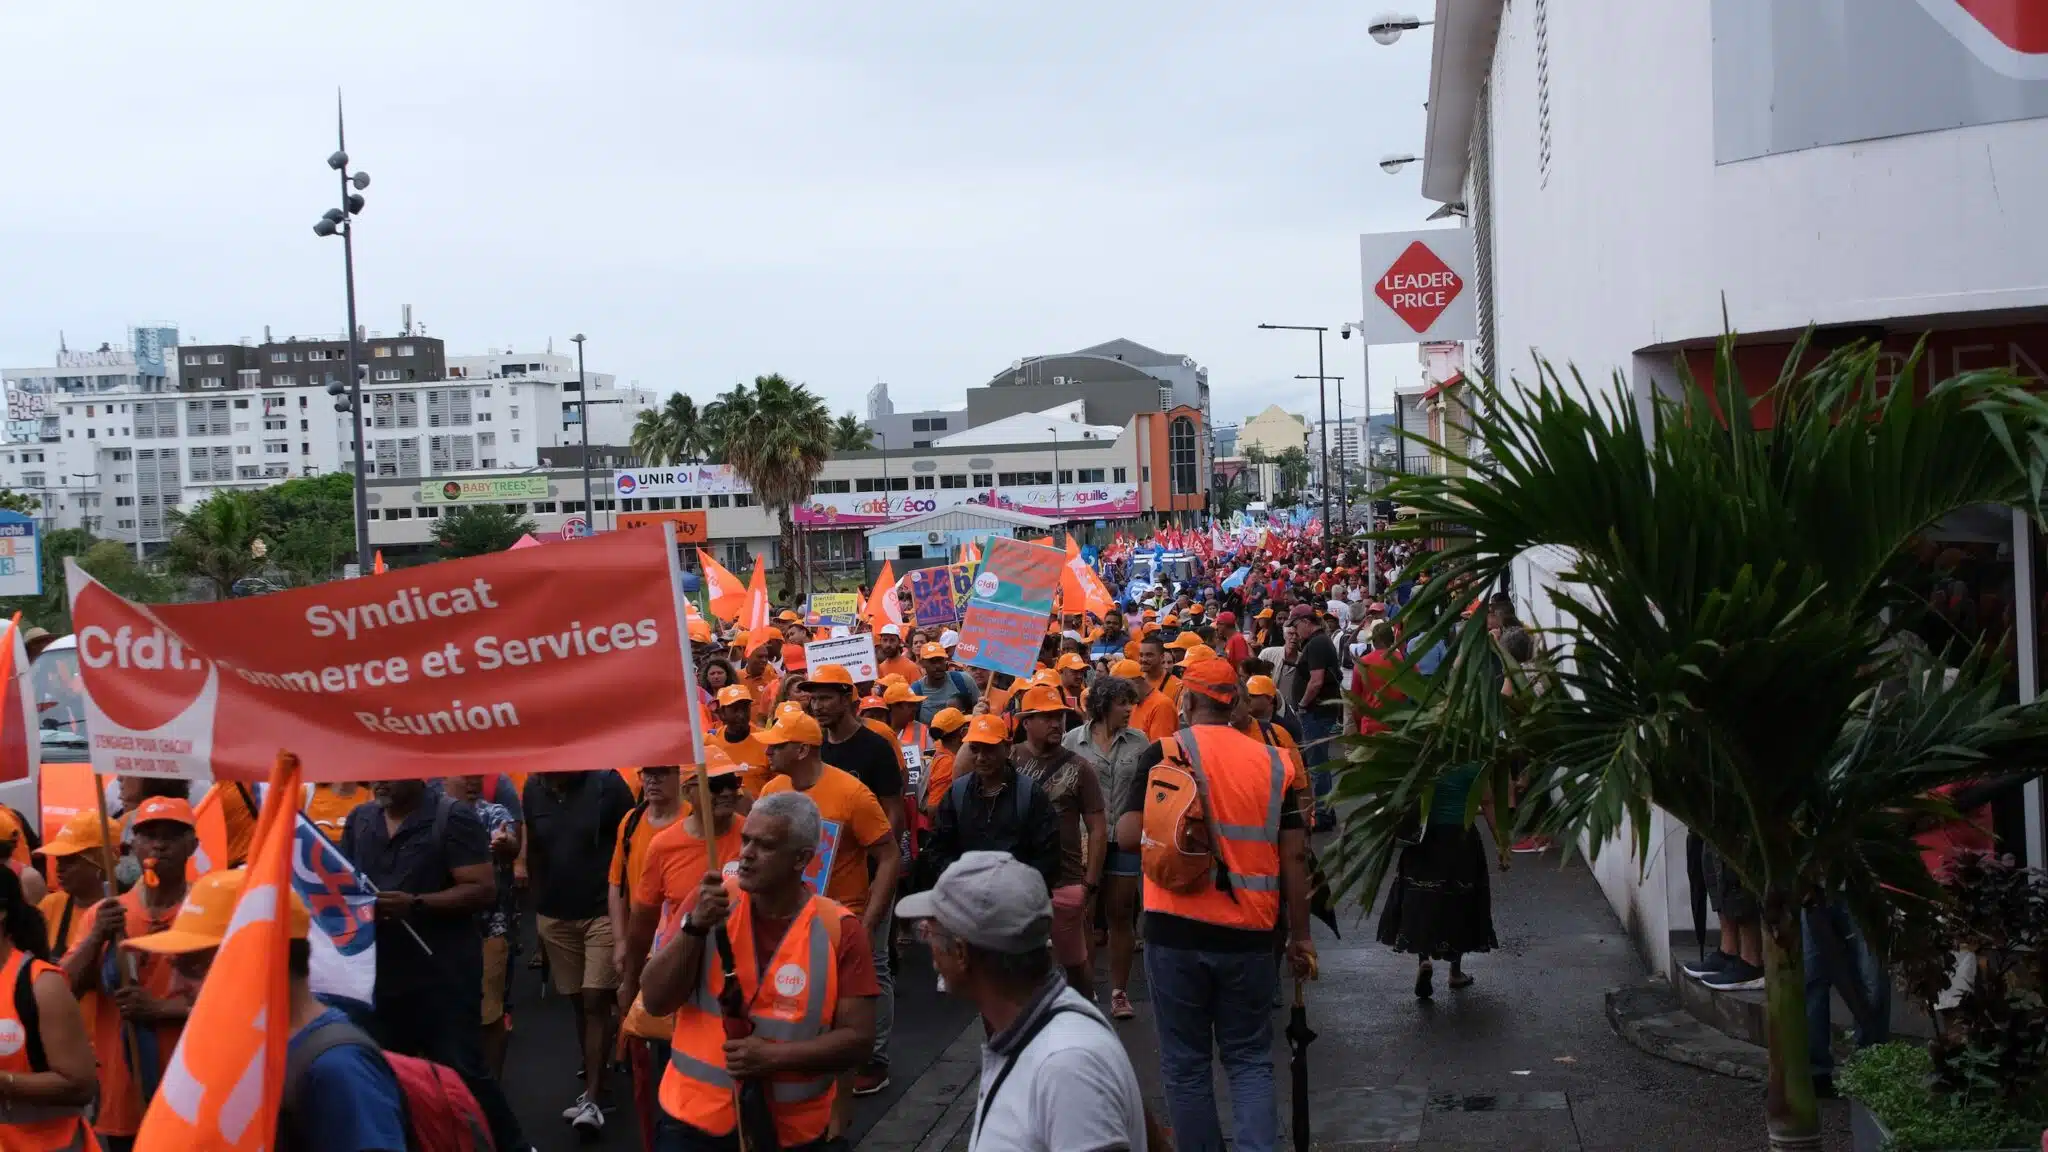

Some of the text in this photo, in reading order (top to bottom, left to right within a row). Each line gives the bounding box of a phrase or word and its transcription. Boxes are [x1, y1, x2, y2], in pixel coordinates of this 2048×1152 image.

[1384, 272, 1455, 290] LEADER
[1392, 291, 1446, 309] PRICE
[463, 483, 492, 492] BABY
[493, 480, 527, 491] TREES
[306, 577, 498, 641] Syndicat
[820, 606, 849, 614] PERDU
[216, 618, 658, 692] ommerce et Services
[957, 641, 978, 653] Cfdt:
[354, 701, 520, 736] Réunion
